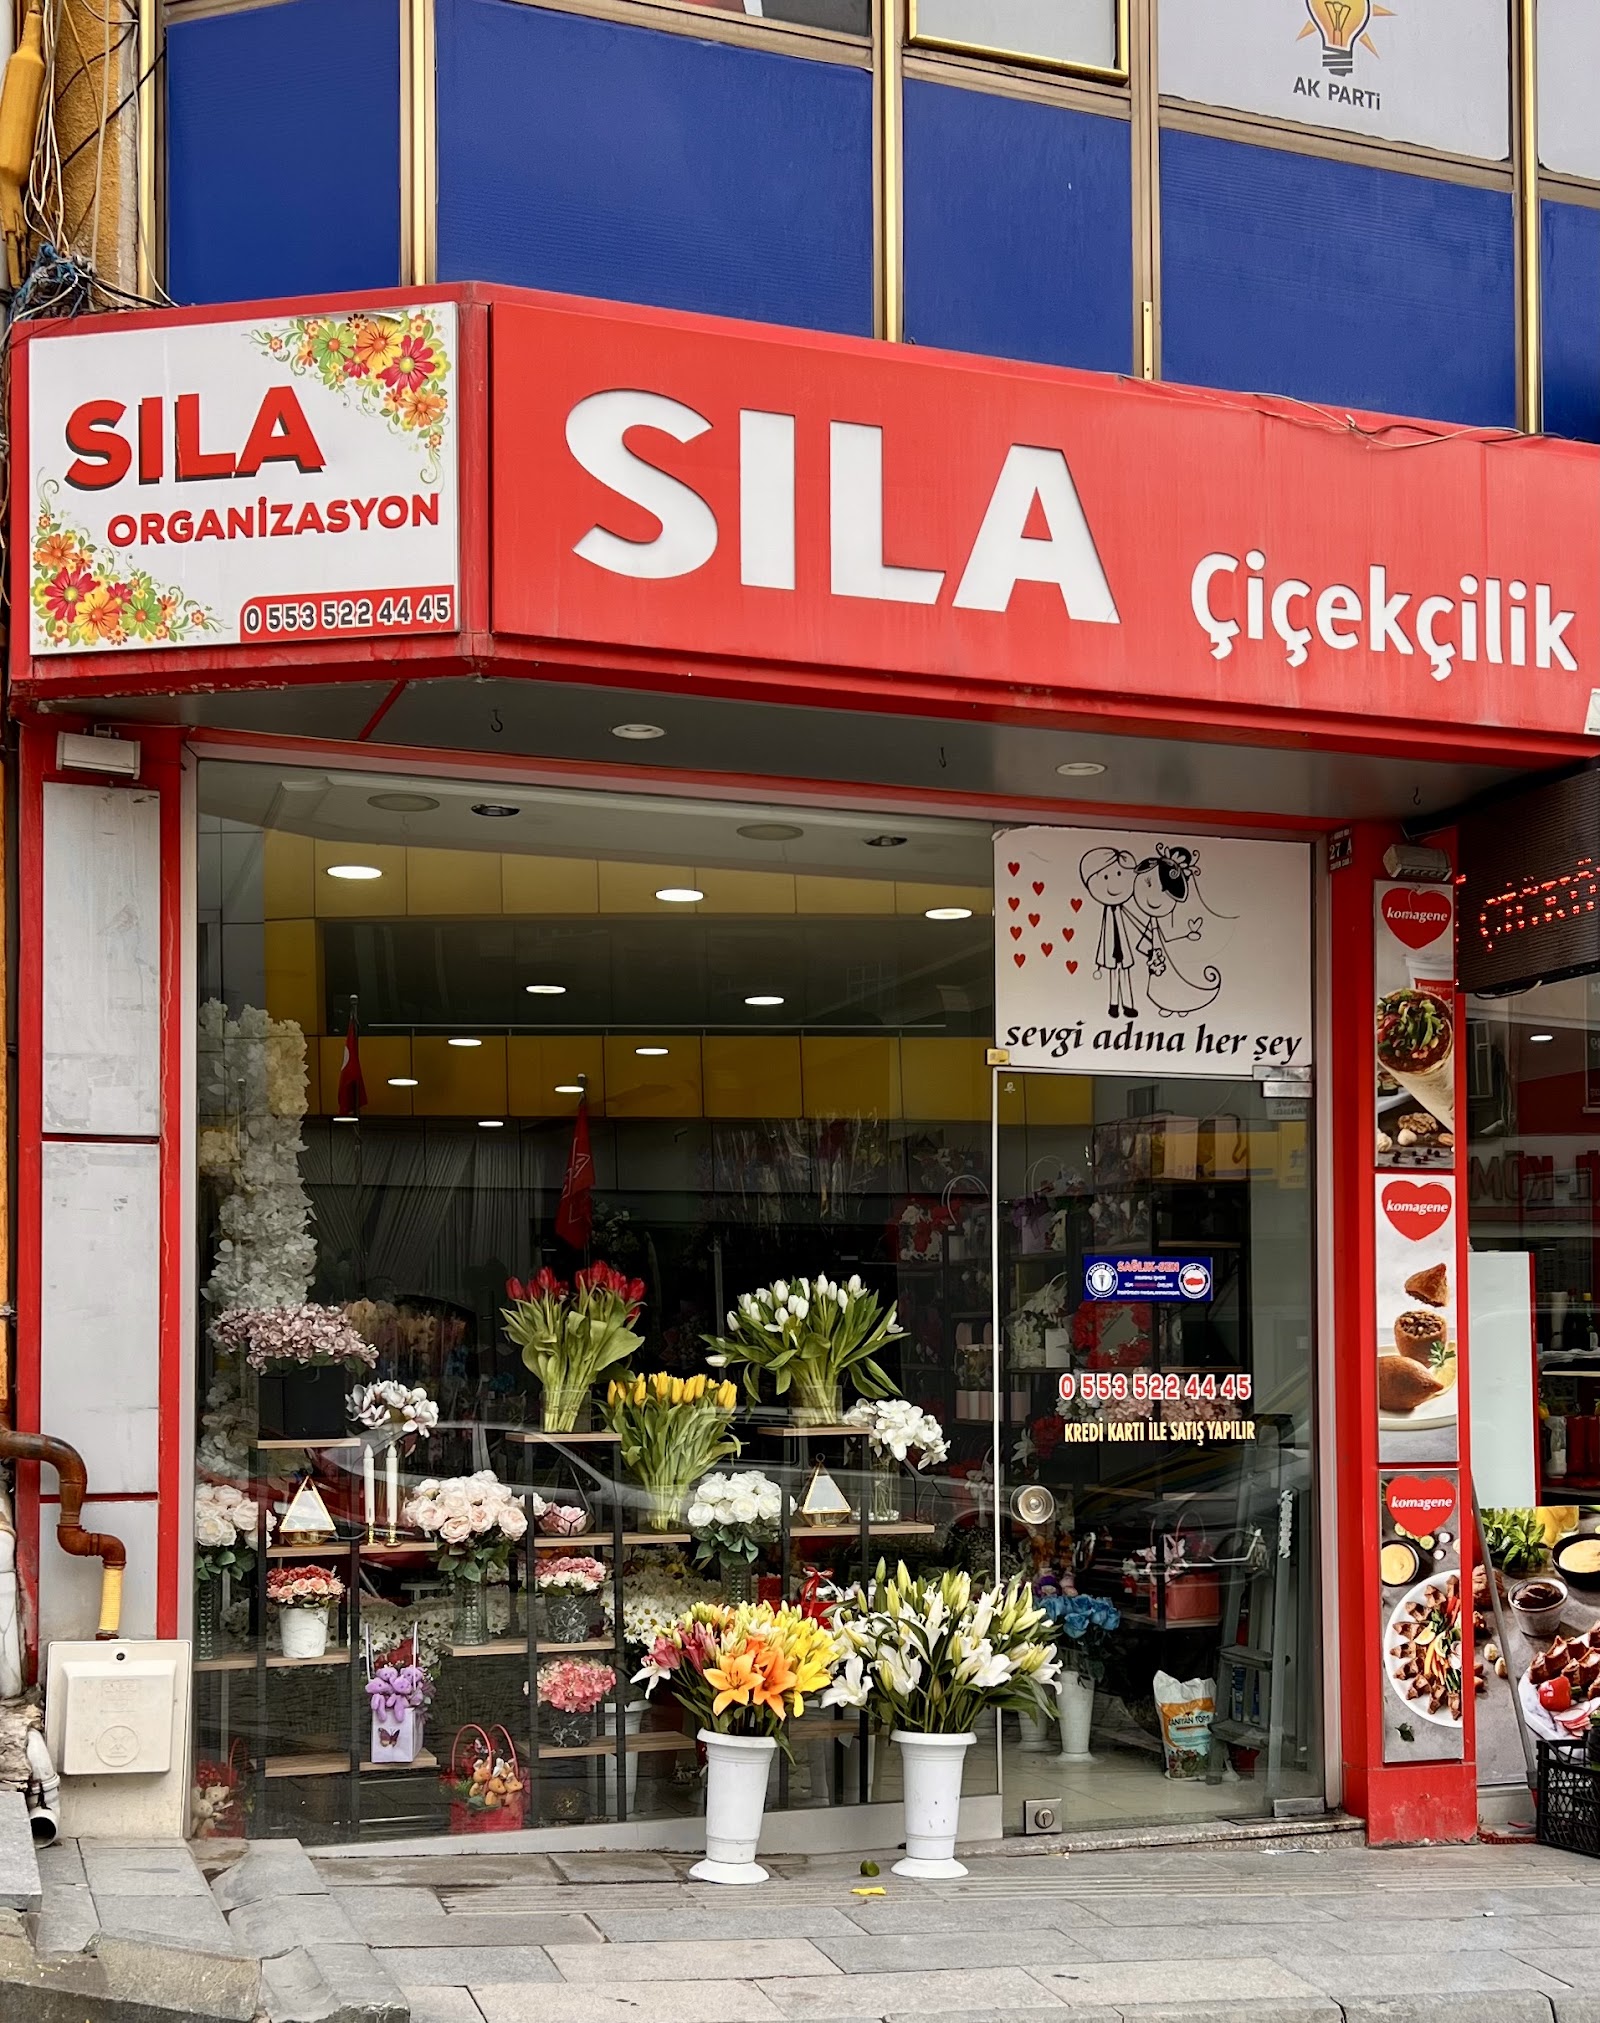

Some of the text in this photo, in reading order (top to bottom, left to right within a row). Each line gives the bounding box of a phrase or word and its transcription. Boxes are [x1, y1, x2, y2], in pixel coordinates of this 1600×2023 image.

[1292, 76, 1321, 98] AK
[64, 385, 326, 492] SILA
[107, 494, 439, 548] ORGANİZASYON
[565, 391, 1120, 625] SILA
[245, 596, 450, 633] 0 553 522 44 45
[1191, 549, 1579, 682] Çiçekçilik
[1386, 906, 1448, 924] komagene
[1005, 1019, 1304, 1065] sevgi adına her şey
[1386, 1198, 1448, 1215] komagene
[1059, 1373, 1252, 1400] 0 553 522 44 45
[1064, 1416, 1256, 1446] KREDİ KARTI İLE SATIŞ YAPILIR
[1390, 1496, 1453, 1511] komagene
